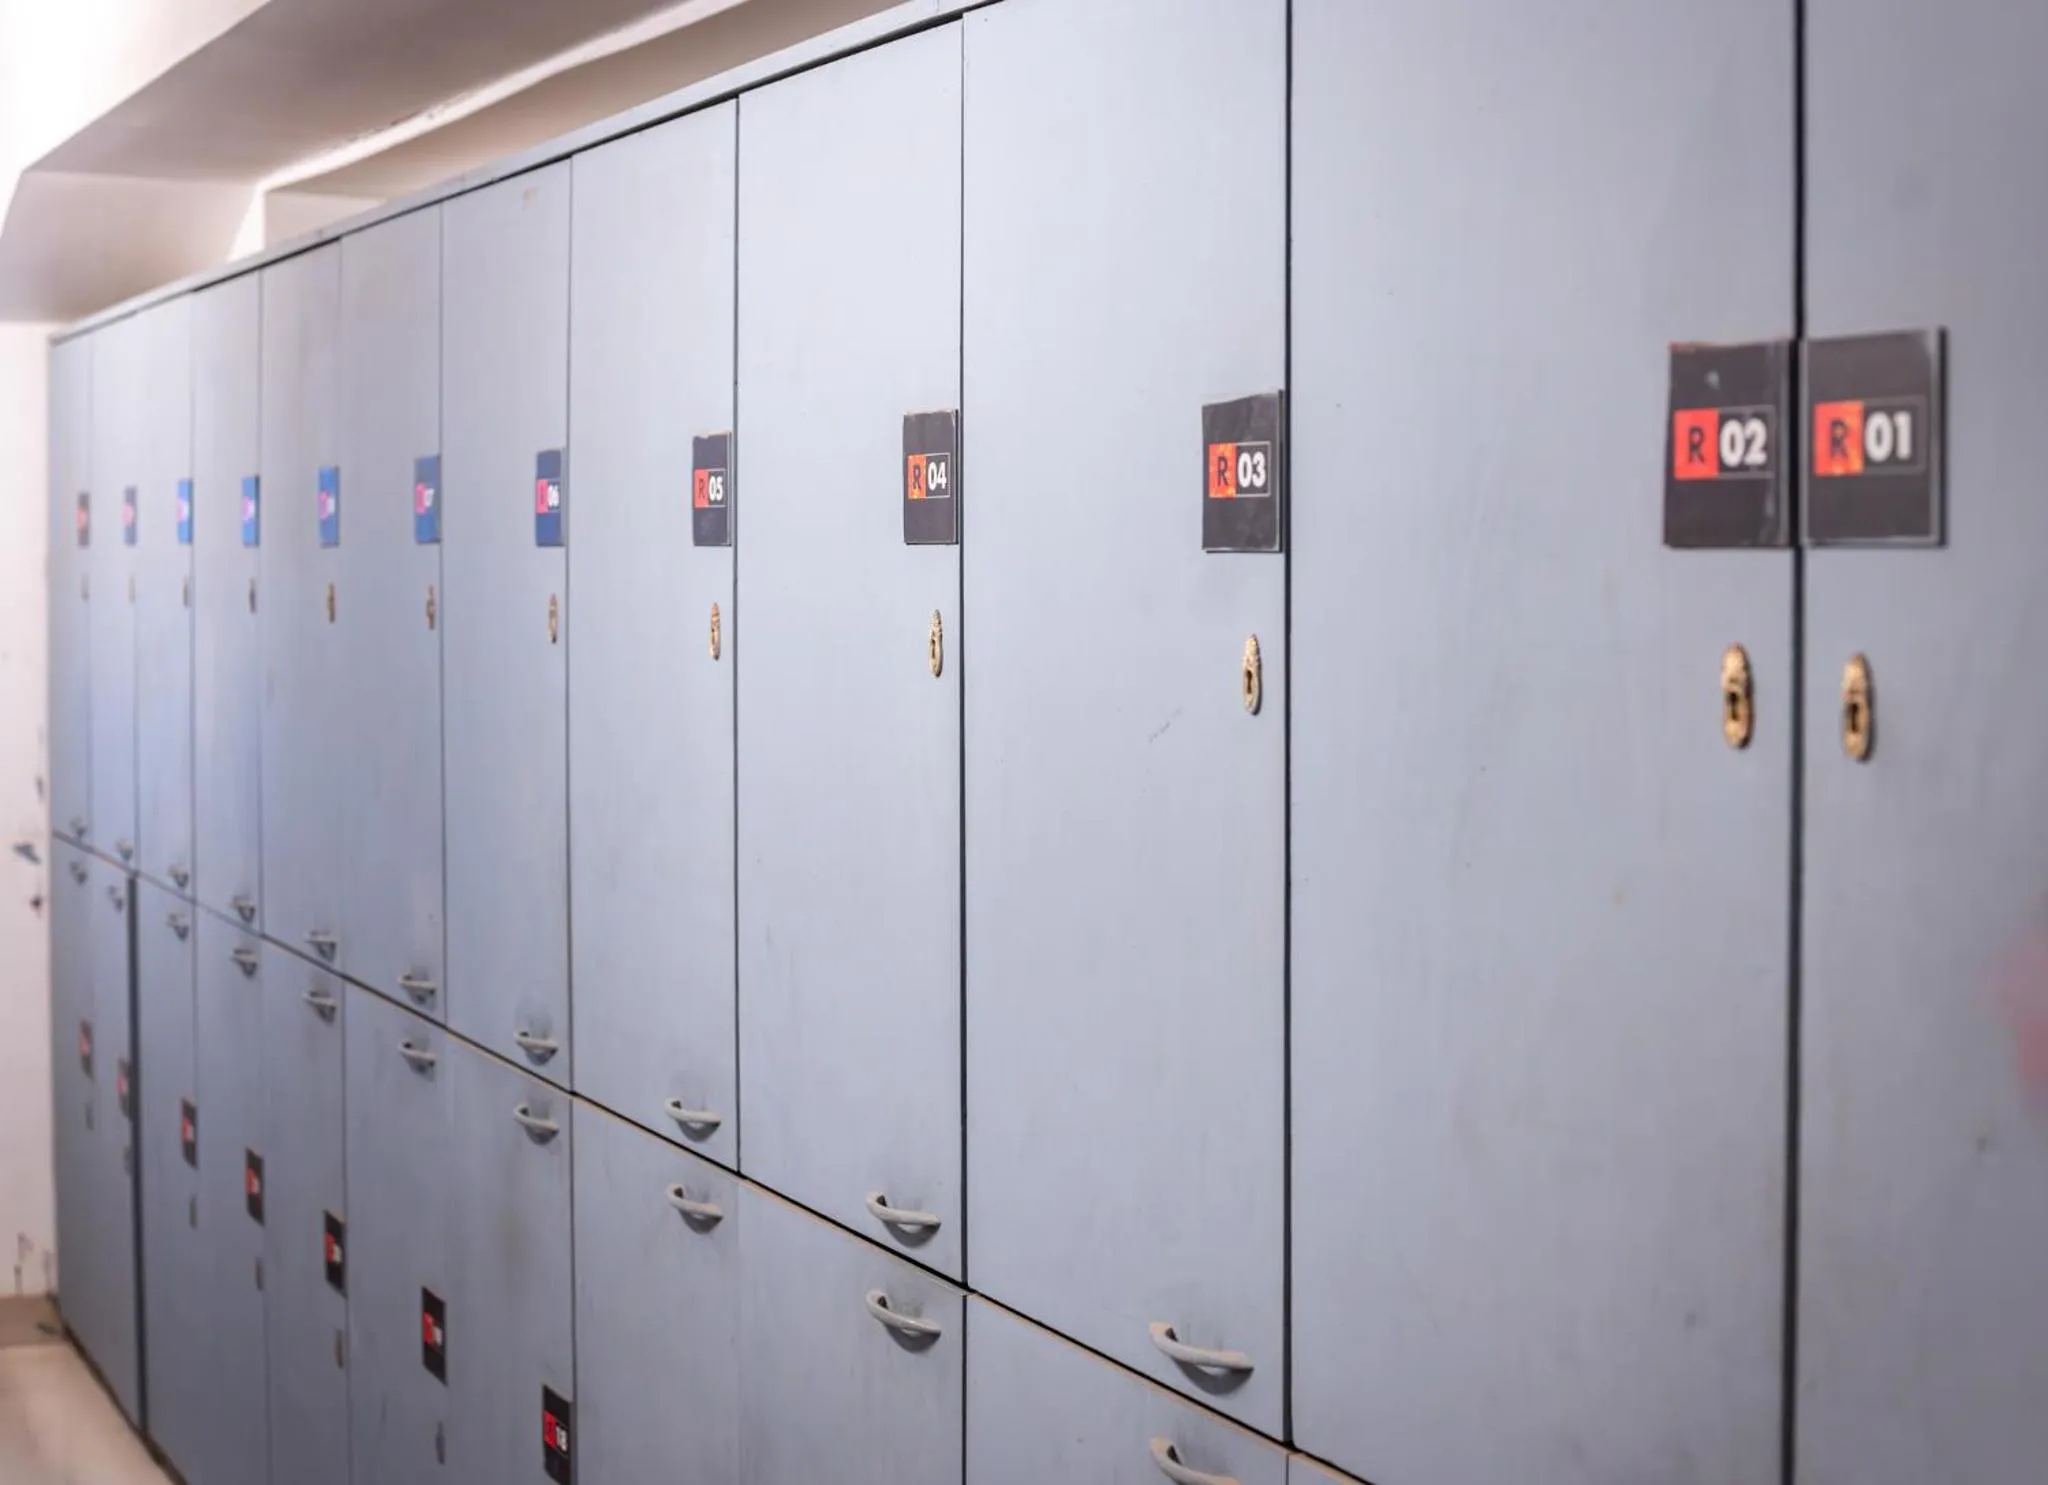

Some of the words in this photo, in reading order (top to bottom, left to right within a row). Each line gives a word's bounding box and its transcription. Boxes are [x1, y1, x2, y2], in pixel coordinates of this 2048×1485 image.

[1688, 426, 1706, 464] R
[1720, 418, 1767, 467] 02
[1830, 418, 1848, 459] R
[1864, 411, 1911, 462] 01
[709, 476, 723, 500] 05
[913, 464, 922, 490] R
[928, 462, 947, 490] 04
[1217, 455, 1229, 487] R
[1238, 451, 1266, 488] 03
